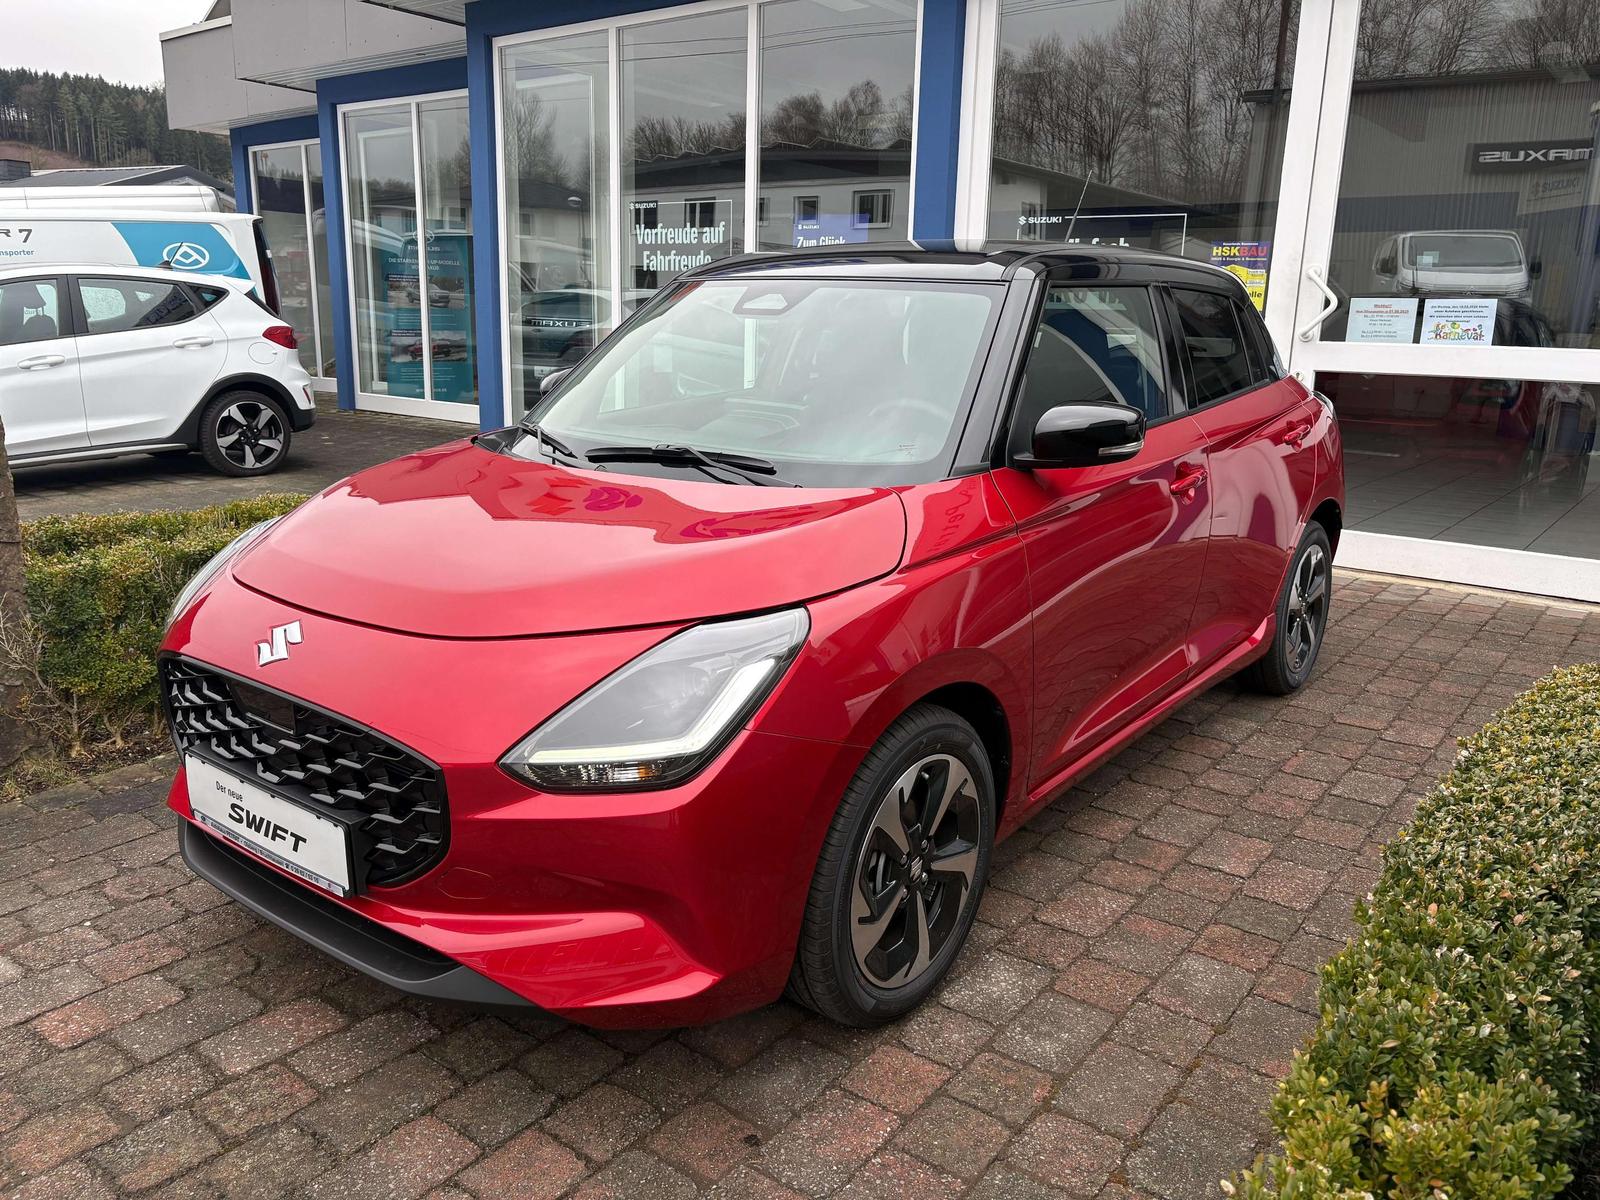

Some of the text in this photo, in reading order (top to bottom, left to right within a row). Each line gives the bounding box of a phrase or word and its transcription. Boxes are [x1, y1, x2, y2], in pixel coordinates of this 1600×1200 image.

[1028, 216, 1063, 224] SUZUKI
[18, 228, 33, 243] 7
[635, 221, 726, 245] Vorfreude auf
[215, 780, 244, 803] Der neue
[228, 802, 307, 853] SWIFT
